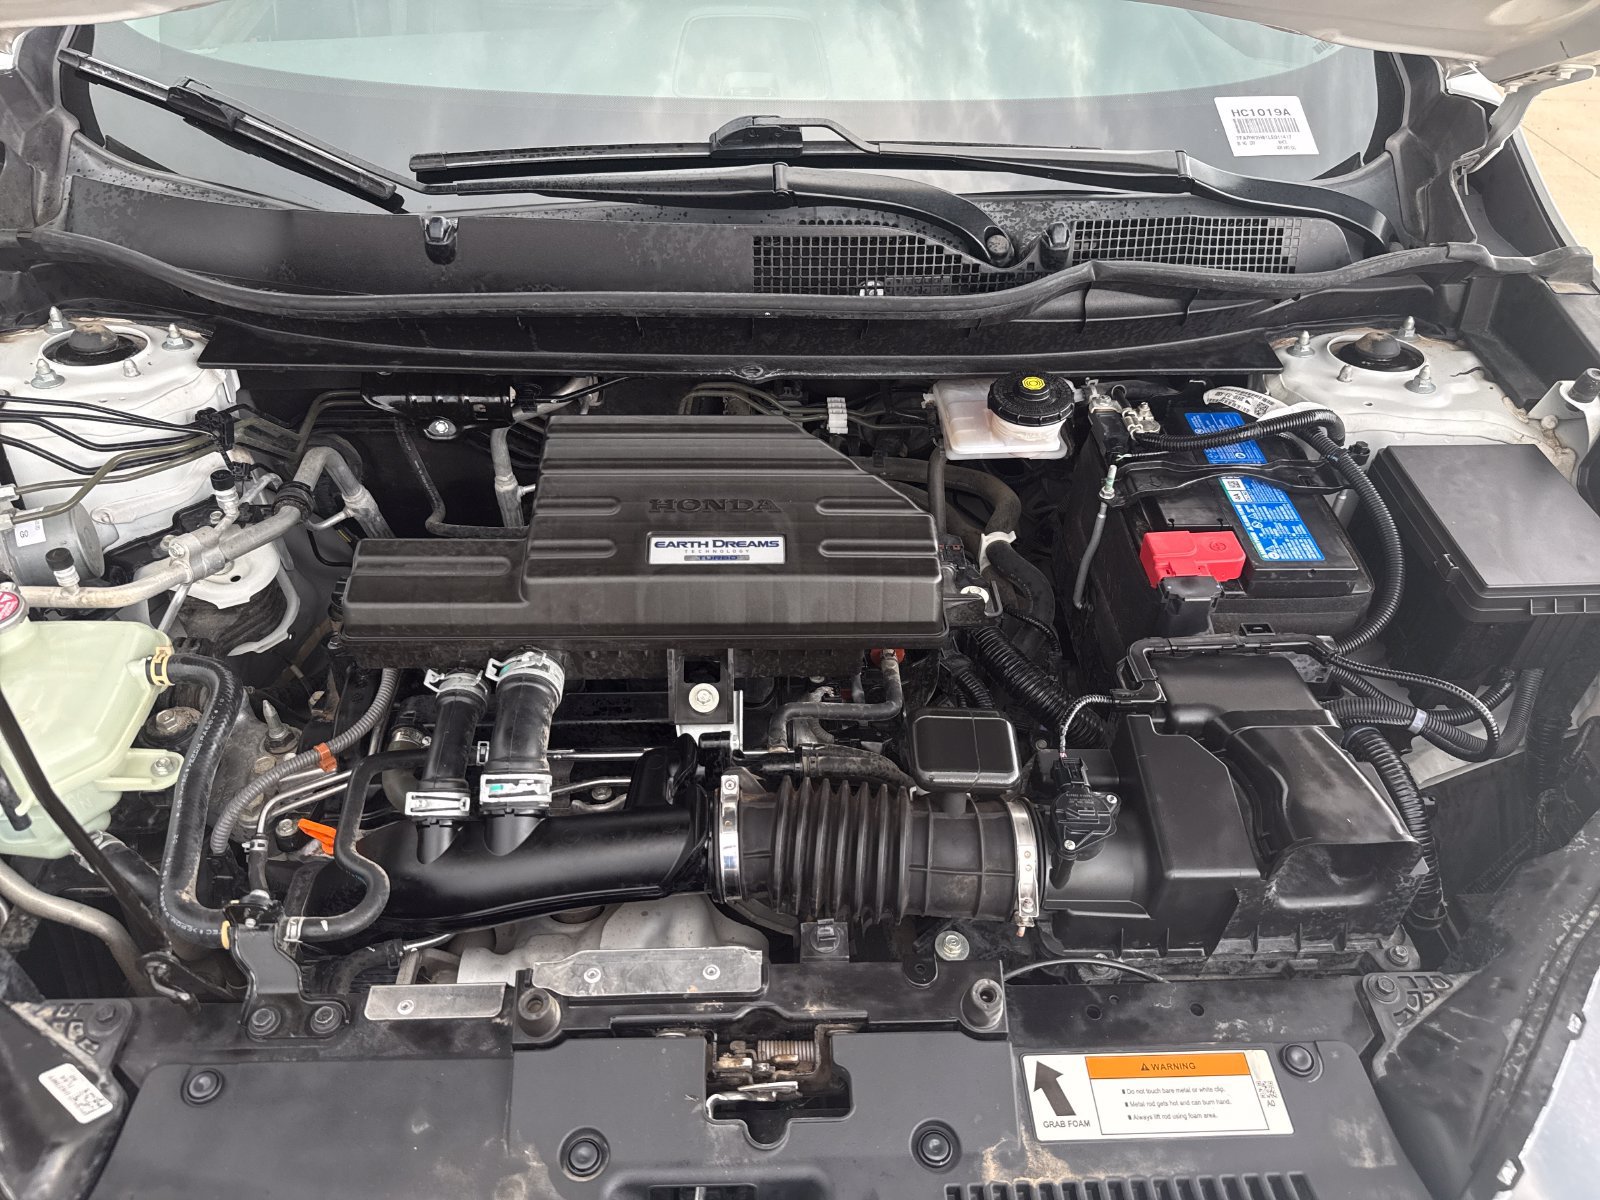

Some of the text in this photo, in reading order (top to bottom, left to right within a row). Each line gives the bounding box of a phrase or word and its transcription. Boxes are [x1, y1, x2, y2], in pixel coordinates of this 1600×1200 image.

[1231, 108, 1291, 117] HC1019A
[649, 499, 782, 513] HONDA
[654, 539, 780, 549] EARTH DREAMS
[1151, 1062, 1196, 1071] WARNING
